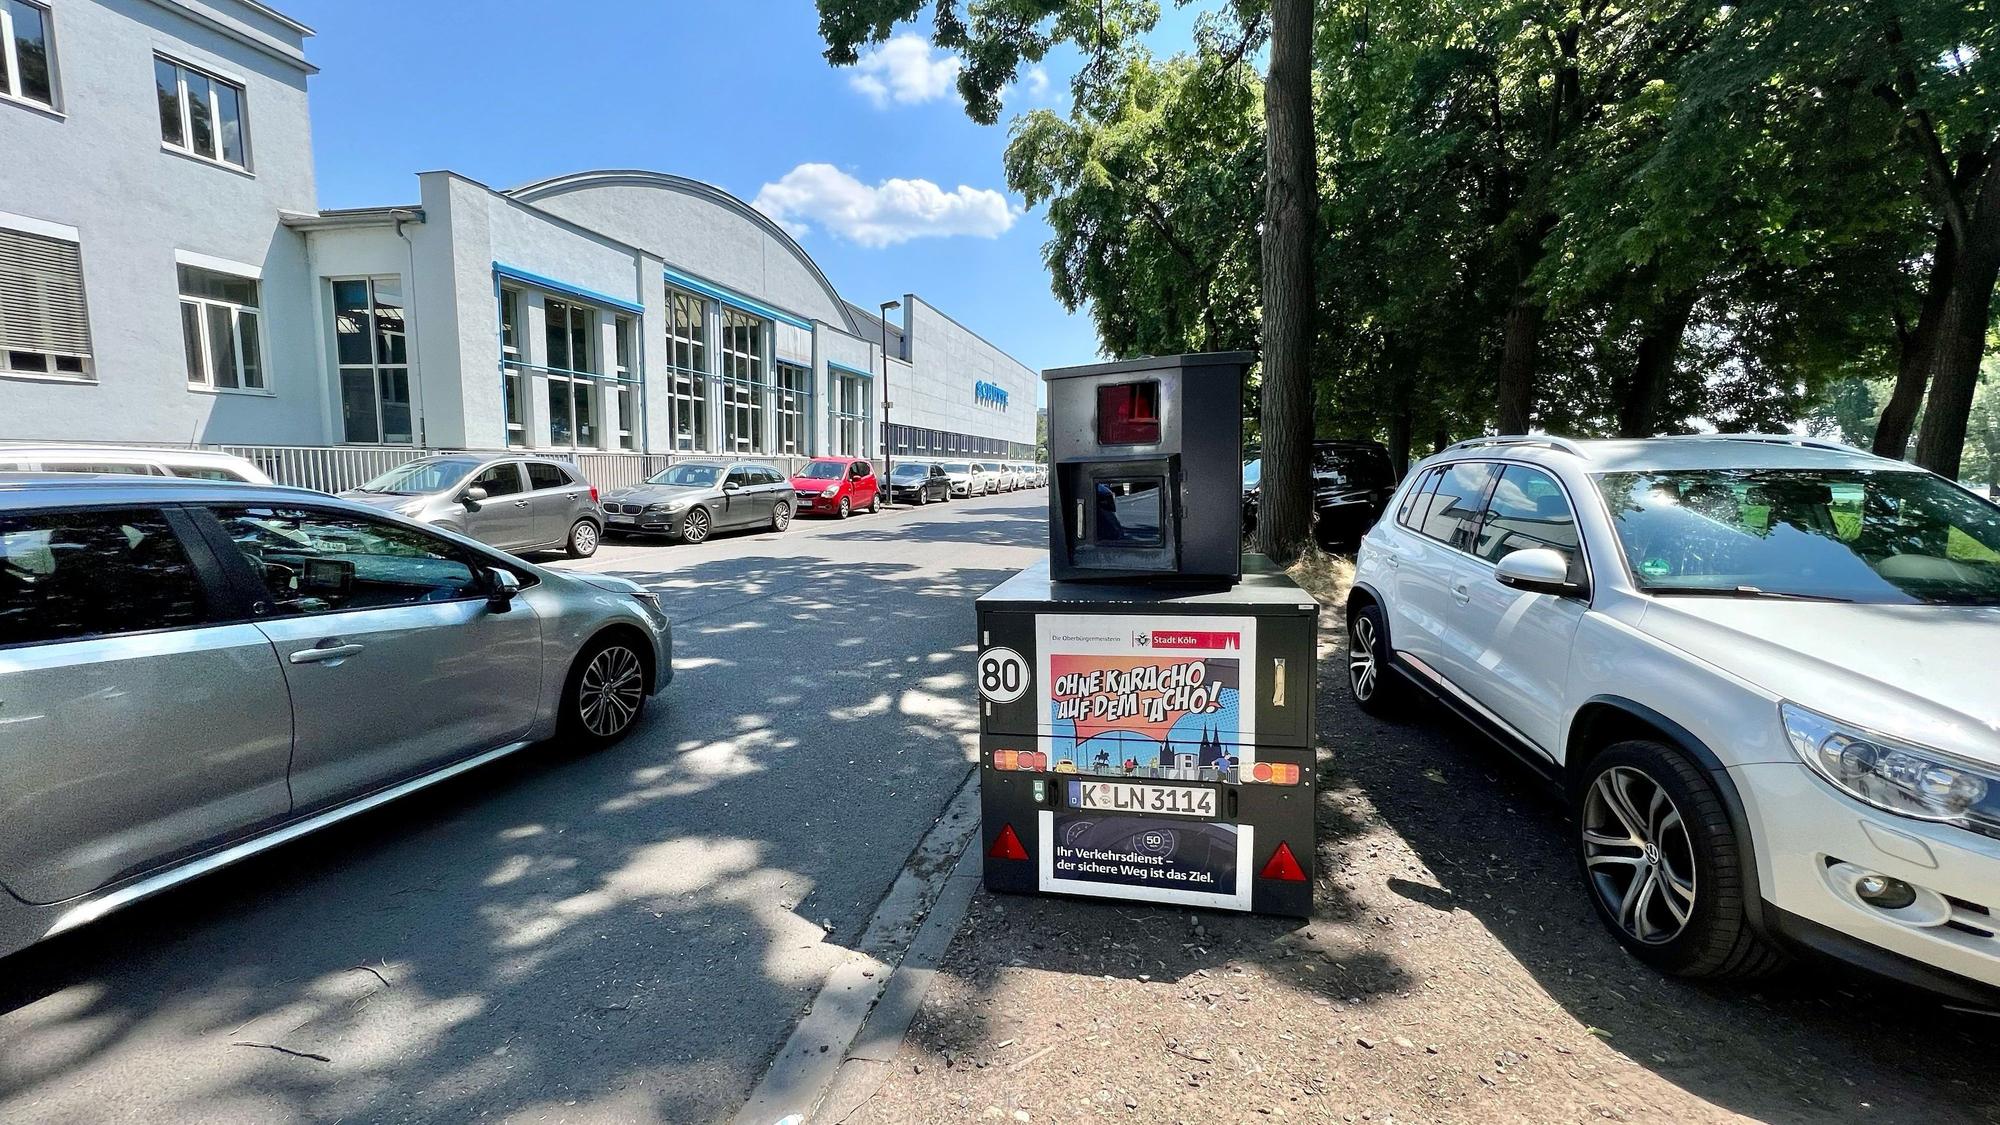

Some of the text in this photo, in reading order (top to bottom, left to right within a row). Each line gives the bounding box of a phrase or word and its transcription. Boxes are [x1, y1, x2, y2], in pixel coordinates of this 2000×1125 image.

[1153, 636, 1197, 645] Stadt Köln
[982, 658, 1020, 693] 80
[1055, 660, 1206, 698] OHNE KARACHO
[1057, 681, 1223, 723] AUF DEM TACHO!
[1082, 784, 1212, 815] K LN 3114
[1146, 836, 1161, 845] 50
[1057, 846, 1073, 858] Ihr
[1075, 848, 1164, 865] Verkehrsdienst
[1057, 859, 1215, 884] der sichere Weg ist das Ziel.
